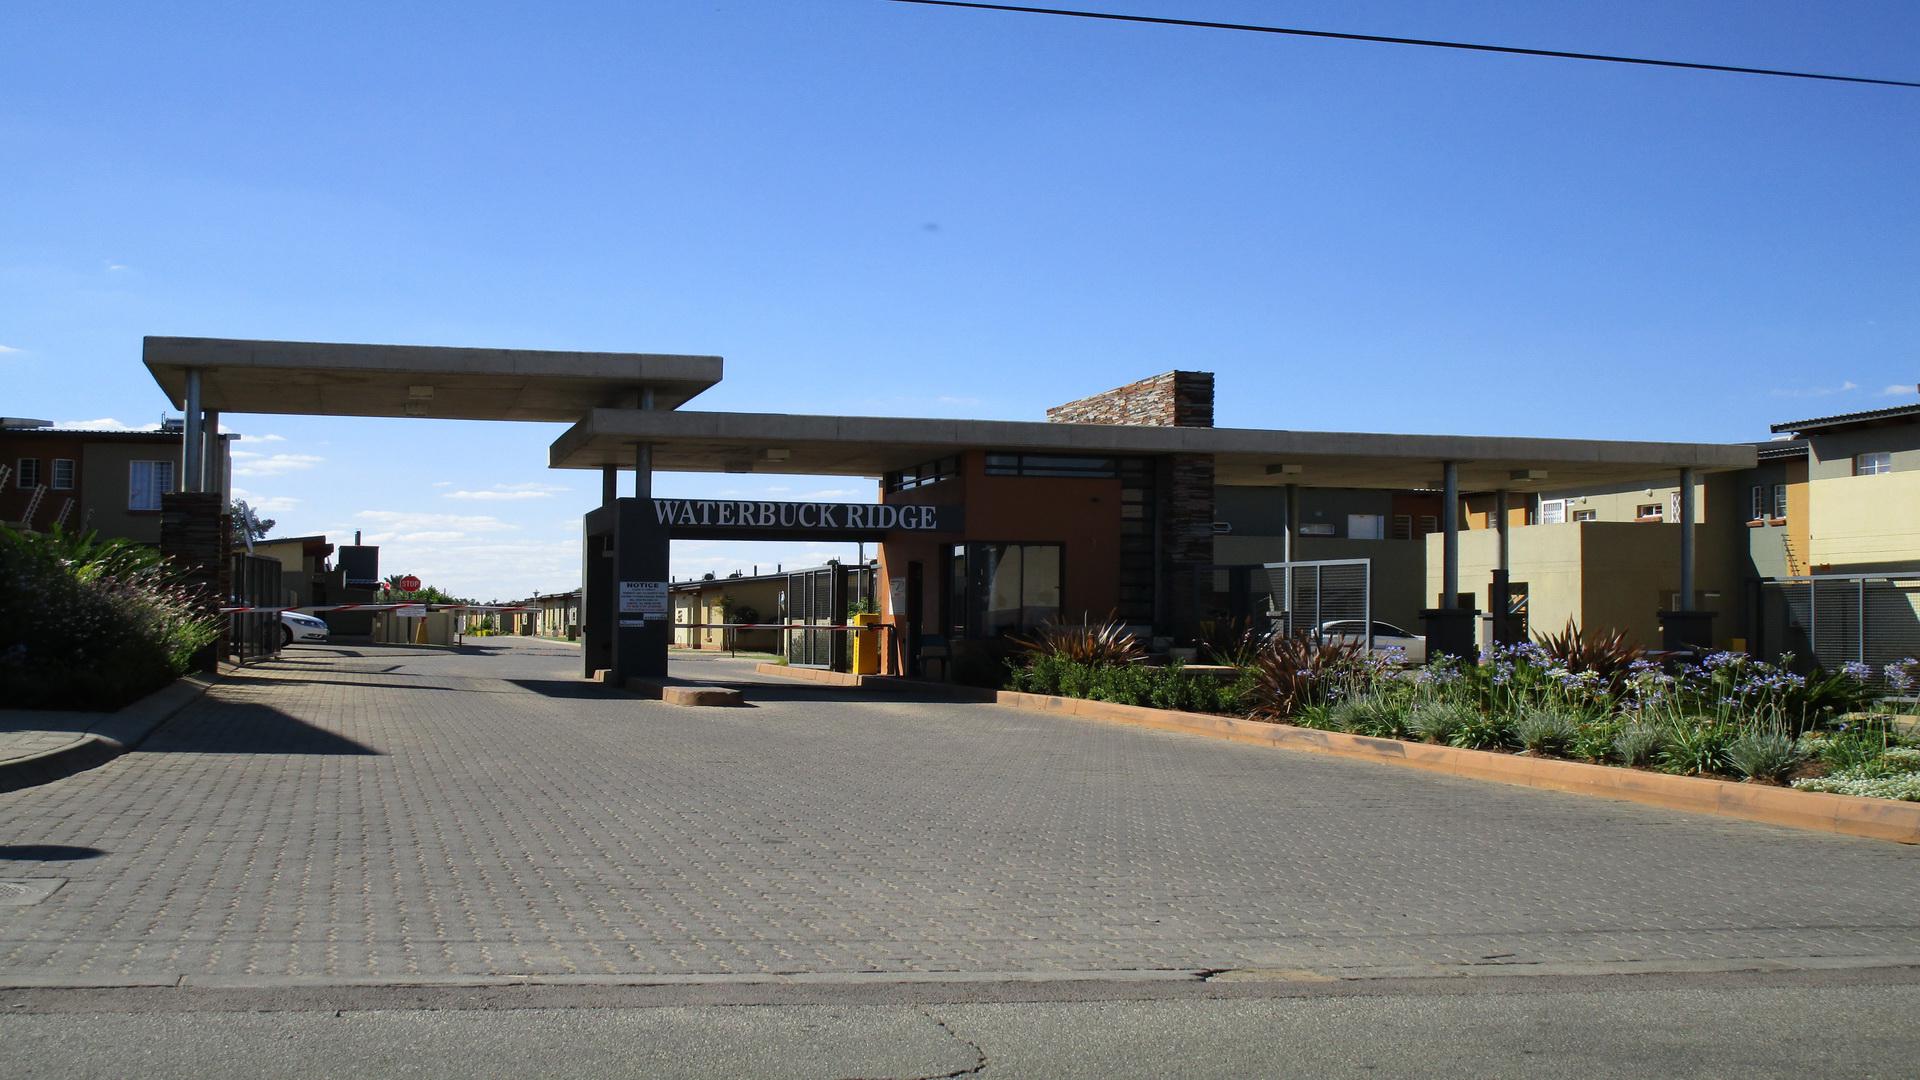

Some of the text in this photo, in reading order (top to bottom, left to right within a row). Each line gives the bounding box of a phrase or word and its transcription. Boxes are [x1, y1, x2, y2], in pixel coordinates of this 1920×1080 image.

[653, 499, 937, 530] WATERBUCK RIDGE
[401, 580, 420, 588] STOP
